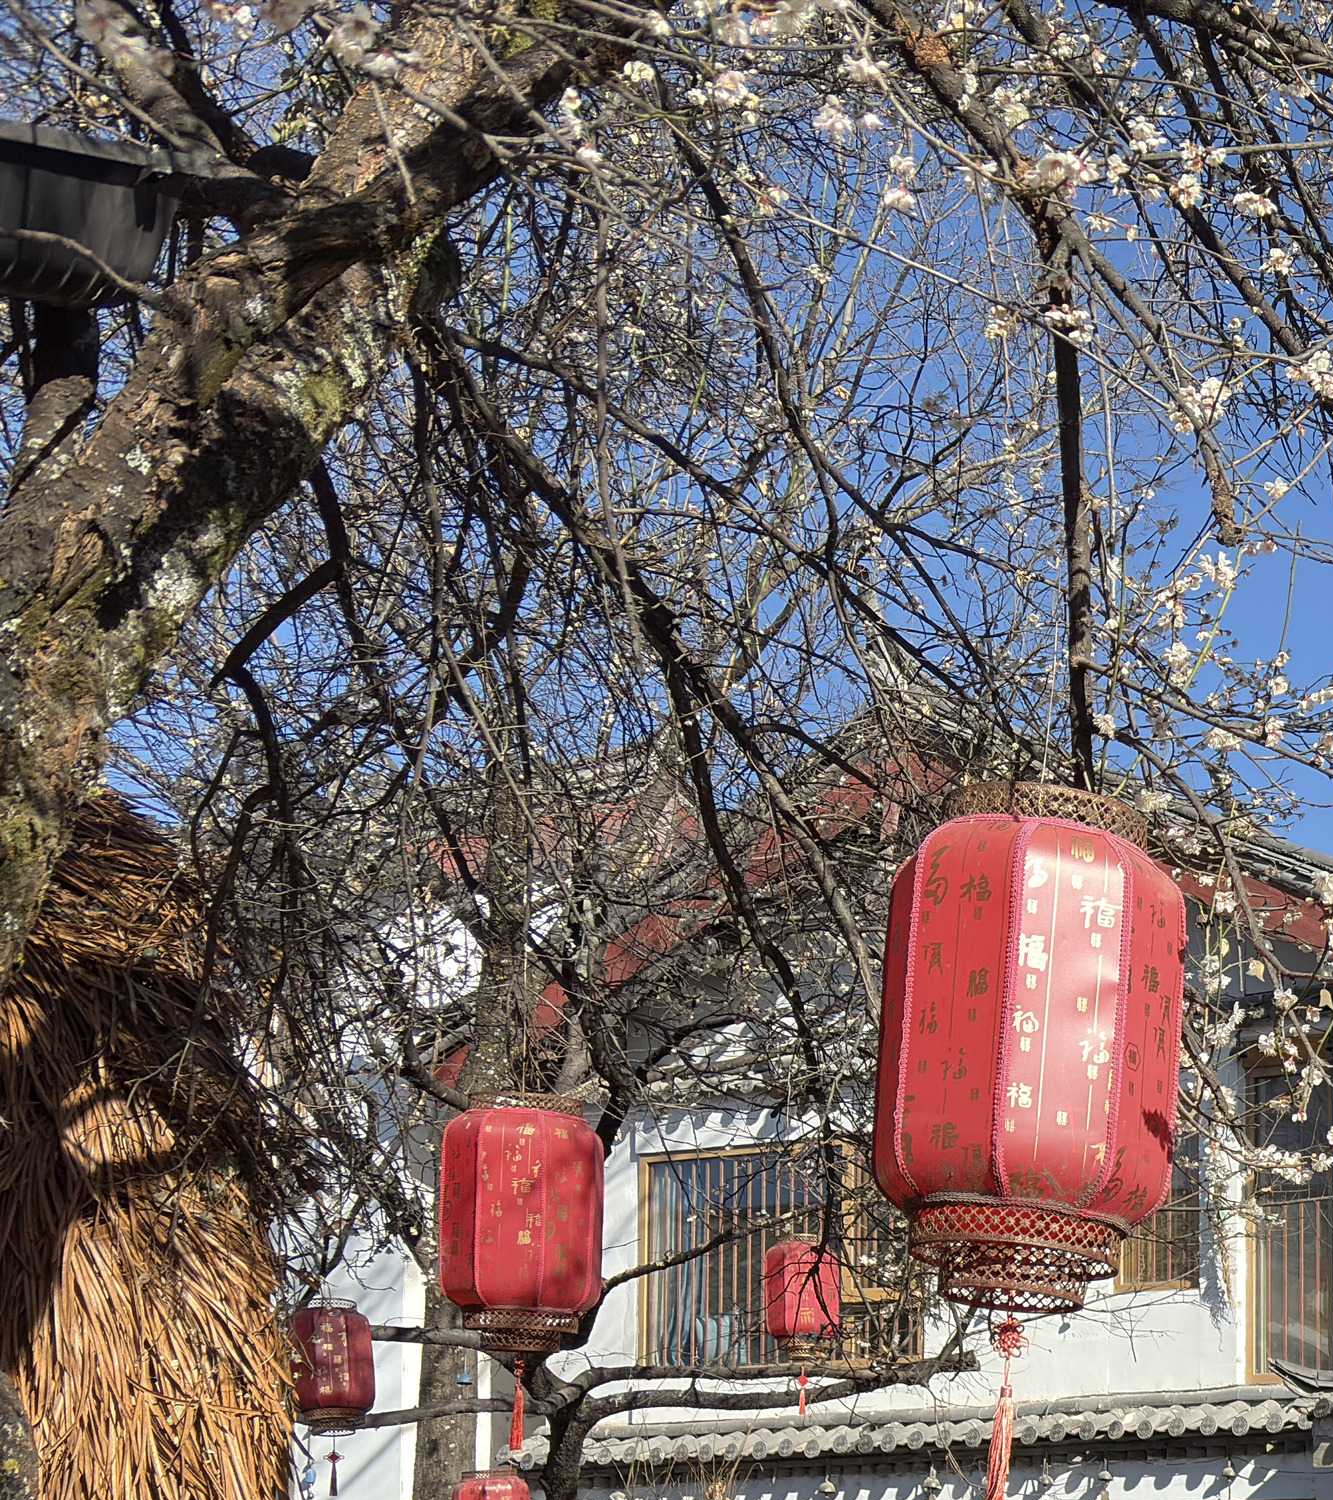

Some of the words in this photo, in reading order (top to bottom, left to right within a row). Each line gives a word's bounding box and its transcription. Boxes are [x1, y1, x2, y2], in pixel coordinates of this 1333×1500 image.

[1071, 836, 1095, 862] 福
[959, 873, 993, 903] 福
[1080, 895, 1123, 928] 福
[1019, 933, 1049, 971] 福
[967, 969, 990, 998] 福
[1141, 965, 1160, 993] 福
[919, 1002, 938, 1034] 福
[1013, 1005, 1039, 1033] 福
[1079, 1028, 1110, 1064] 福
[940, 1048, 967, 1080] 福
[1007, 1083, 1032, 1108] 福
[930, 1122, 959, 1150] 福
[510, 1177, 535, 1195] 福
[517, 1230, 531, 1245] 福
